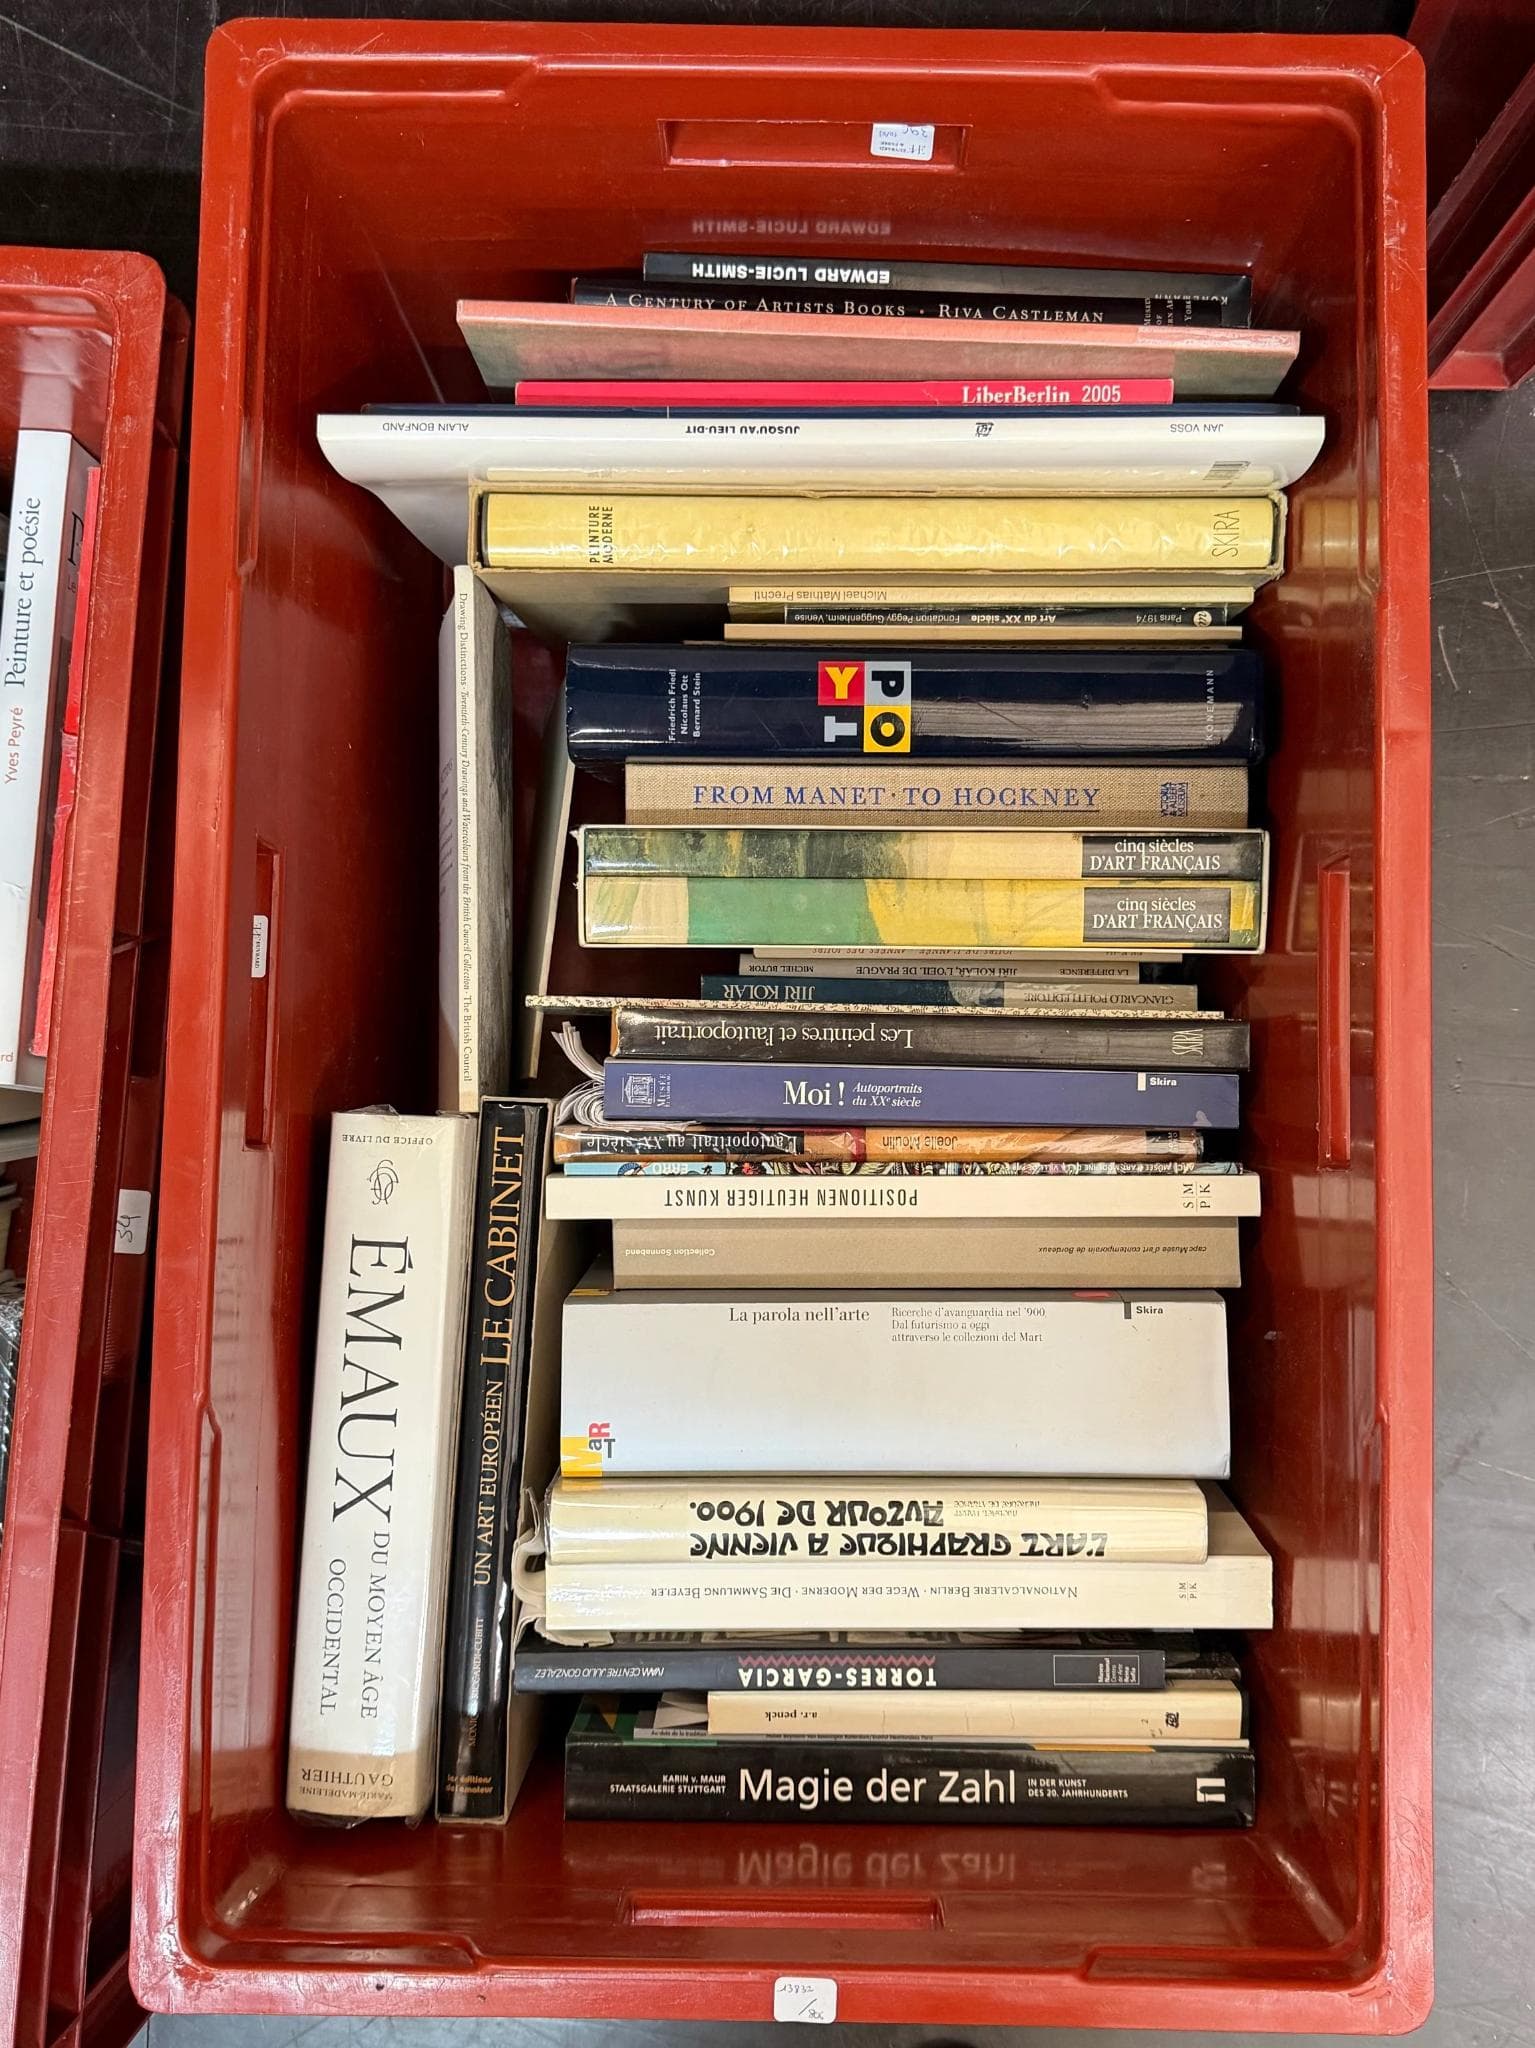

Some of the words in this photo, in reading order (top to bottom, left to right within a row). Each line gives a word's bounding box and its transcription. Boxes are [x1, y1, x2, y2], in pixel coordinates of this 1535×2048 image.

[692, 262, 808, 281] LUCIE-SMITH
[814, 267, 891, 284] EDWARD
[628, 293, 716, 314] CENTURY
[757, 298, 835, 316] ARTISTS
[844, 300, 906, 317] BOOKS
[939, 304, 983, 320] RIVA
[992, 306, 1103, 323] CASTLEMAN
[961, 385, 1070, 406] LiberBerlin
[1082, 385, 1121, 404] 2005
[382, 422, 435, 431] BONFAND
[438, 423, 469, 432] ALAIN
[686, 423, 733, 435] LIEU-DIT
[1170, 422, 1200, 433] VOSS
[1203, 423, 1225, 433] JAN
[21, 497, 45, 566] poésie
[588, 504, 600, 564] PEINTURE
[602, 505, 613, 564] MODERNE
[1212, 509, 1240, 559] SKIRA
[19, 571, 35, 591] et
[754, 591, 794, 601] Prechtl
[796, 591, 841, 600] Mathias
[843, 591, 887, 600] Michael
[457, 592, 468, 630] Drawing
[794, 614, 824, 623] Venise
[826, 614, 886, 624] Guggenheim,
[887, 613, 914, 623] Peggy
[915, 614, 960, 623] Fondation
[1024, 614, 1036, 623] du
[1037, 614, 1056, 624] Art
[1136, 614, 1157, 624] 1974
[1160, 614, 1182, 623] Paris
[5, 597, 34, 687] Peinture
[459, 632, 469, 686] Distinctions
[668, 668, 676, 695] Friedl
[680, 674, 688, 689] Ott
[692, 672, 701, 697] Stein
[668, 697, 676, 741] Friedrich
[680, 691, 688, 736] Nicolaus
[692, 699, 701, 738] Bernard
[8, 707, 24, 748] Peyré
[5, 752, 19, 784] Yves
[459, 760, 470, 796] Drawings
[693, 785, 774, 806] FROM
[903, 787, 942, 806] TO
[953, 787, 1100, 807] HOCKNEY
[461, 798, 470, 813] and
[461, 814, 471, 861] Watercolours
[1114, 839, 1146, 858] cinq
[1149, 839, 1194, 853] siècles
[460, 864, 471, 882] from
[1090, 855, 1136, 871] D'ART
[1141, 855, 1220, 874] FRANÇAIS
[462, 883, 471, 895] the
[462, 897, 471, 922] British
[1117, 898, 1148, 916] cinq
[1151, 897, 1196, 911] siècles
[1092, 914, 1139, 929] D'ART
[1143, 914, 1223, 932] FRANÇAIS
[462, 923, 472, 952] Council
[462, 953, 472, 990] Collection
[749, 964, 778, 972] BUTOR
[780, 965, 813, 973] MICHEL
[856, 966, 900, 975] PRAGUE
[903, 967, 917, 975] DE
[463, 995, 472, 1012] The
[1110, 994, 1174, 1004] GIANCARLO
[463, 1014, 473, 1044] British
[654, 1020, 774, 1047] l'autoportrait
[779, 1027, 797, 1040] et
[802, 1023, 876, 1048] peintres
[880, 1029, 914, 1049] Les
[1172, 1028, 1203, 1056] SKIRA
[463, 1046, 473, 1081] Council
[852, 1082, 923, 1097] Autoportraits
[1150, 1077, 1177, 1087] Skira
[783, 1080, 832, 1107] Moi
[852, 1096, 866, 1106] du
[890, 1095, 921, 1107] siècle
[341, 1134, 373, 1143] LIVRE
[375, 1135, 390, 1144] DU
[392, 1137, 433, 1145] OFFICE
[586, 1136, 632, 1152] siècle
[667, 1136, 685, 1149] au
[882, 1134, 920, 1149] Moulin
[924, 1134, 958, 1149] Joëlle
[664, 1188, 719, 1206] KUNST
[728, 1188, 808, 1206] HEUTIGER
[817, 1188, 918, 1207] POSITIONEN
[484, 1126, 524, 1308] CABINET
[625, 1248, 672, 1257] Sonnabend
[674, 1248, 715, 1257] Collection
[1038, 1246, 1074, 1255] Bordeaux
[1076, 1246, 1086, 1254] de
[1088, 1246, 1141, 1254] contemporain
[729, 1307, 748, 1322] La
[752, 1307, 800, 1325] parola
[805, 1307, 870, 1322] nell'arte
[891, 1307, 932, 1318] Ricerche
[935, 1307, 1003, 1320] d'avanguardia
[1006, 1307, 1021, 1318] nel
[1136, 1305, 1164, 1315] Skira
[891, 1320, 908, 1330] Dal
[910, 1320, 958, 1330] futurismo
[969, 1320, 990, 1332] oggi
[480, 1317, 513, 1367] LE
[891, 1332, 939, 1343] attraverso
[942, 1332, 950, 1343] le
[953, 1332, 1000, 1343] collezioni
[1002, 1332, 1017, 1343] del
[1019, 1332, 1043, 1343] Mart
[332, 1233, 414, 1523] ÉMAUX
[478, 1380, 503, 1498] EUROPÉEN
[689, 1500, 765, 1527] 1900.
[776, 1500, 815, 1527] DE
[825, 1500, 944, 1527] AUTOUR
[477, 1500, 496, 1548] ART
[372, 1531, 391, 1566] DU
[689, 1532, 798, 1560] VIENNE
[807, 1532, 828, 1557] A
[839, 1532, 1011, 1557] GRAPHIQUE
[1019, 1532, 1108, 1557] L'ART
[473, 1552, 493, 1587] UN
[651, 1587, 701, 1599] BEYELER
[704, 1586, 768, 1598] SAMMLUNG
[771, 1586, 791, 1598] DIE
[801, 1586, 858, 1598] MODERNE
[861, 1586, 883, 1598] DER
[886, 1586, 919, 1598] WEGE
[930, 1586, 970, 1598] BERLIN
[972, 1586, 1078, 1598] NATIONALGALERIE
[365, 1568, 387, 1664] MOYEN
[320, 1558, 347, 1716] OCCIDENTAL
[582, 1667, 607, 1677] JULIO
[607, 1667, 641, 1677] CENTRE
[738, 1667, 937, 1688] TORRES-GARCIA
[361, 1671, 384, 1719] ÂGE
[764, 1709, 797, 1721] penck
[300, 1767, 394, 1788] GAUTHIER
[662, 1774, 689, 1783] KARIN
[700, 1774, 726, 1784] MAUR
[1028, 1778, 1037, 1788] IN
[1039, 1778, 1056, 1788] DER
[1058, 1778, 1087, 1788] KUNST
[610, 1784, 676, 1793] STAATSGALERIE
[677, 1784, 726, 1794] STUTTGART
[739, 1768, 853, 1810] Magie
[866, 1768, 927, 1803] der
[938, 1769, 1016, 1803] Zahl
[1028, 1788, 1044, 1798] DES
[1061, 1788, 1128, 1799] JAHRHUNDERTS
